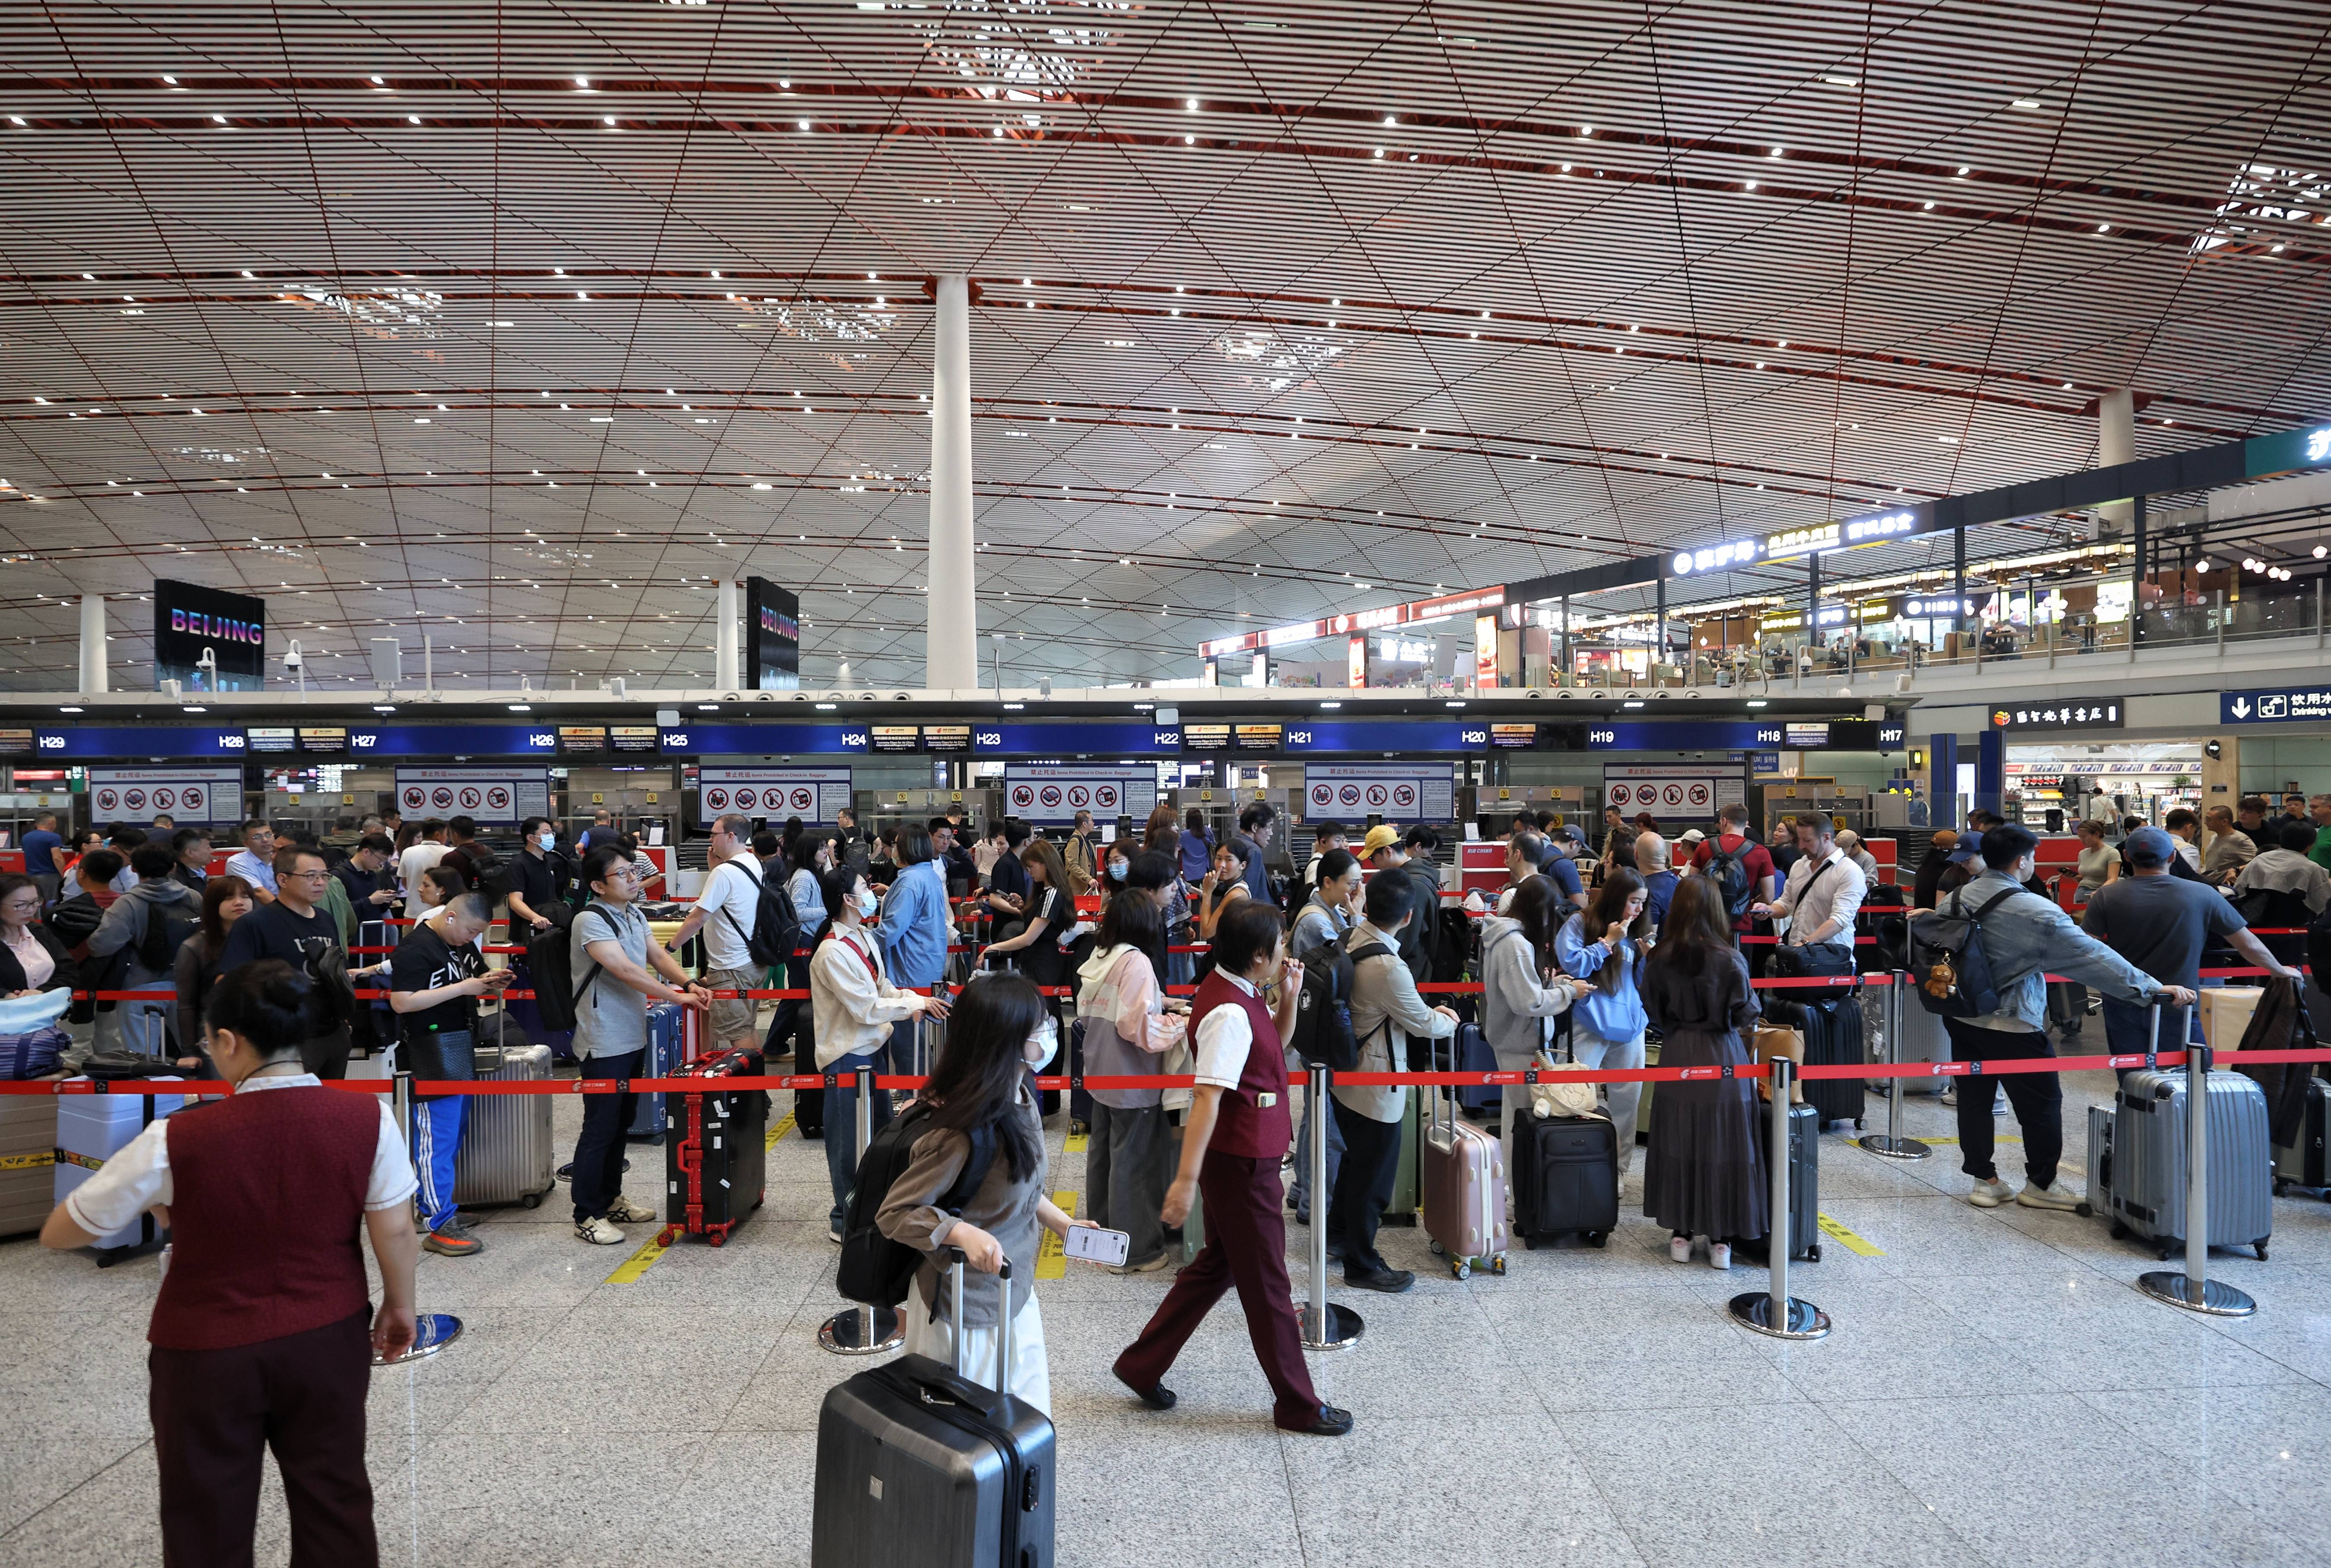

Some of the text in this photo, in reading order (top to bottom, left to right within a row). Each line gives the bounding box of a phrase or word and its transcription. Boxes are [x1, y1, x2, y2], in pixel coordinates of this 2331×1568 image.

[172, 608, 262, 645] BEIJING
[761, 605, 798, 641] BEIJING
[2292, 707, 2327, 717] Drinking
[352, 735, 376, 746] H27
[530, 735, 554, 746] H26
[664, 734, 688, 746] H25
[842, 734, 866, 745] H24
[977, 734, 1000, 744] H23
[1155, 733, 1178, 744] H22
[1289, 732, 1311, 743] H21
[1462, 731, 1486, 742] H20
[1591, 731, 1614, 742] H19
[1758, 730, 1780, 741] H18
[1880, 730, 1902, 741] H17
[40, 737, 65, 748] H29
[219, 736, 244, 747] H28
